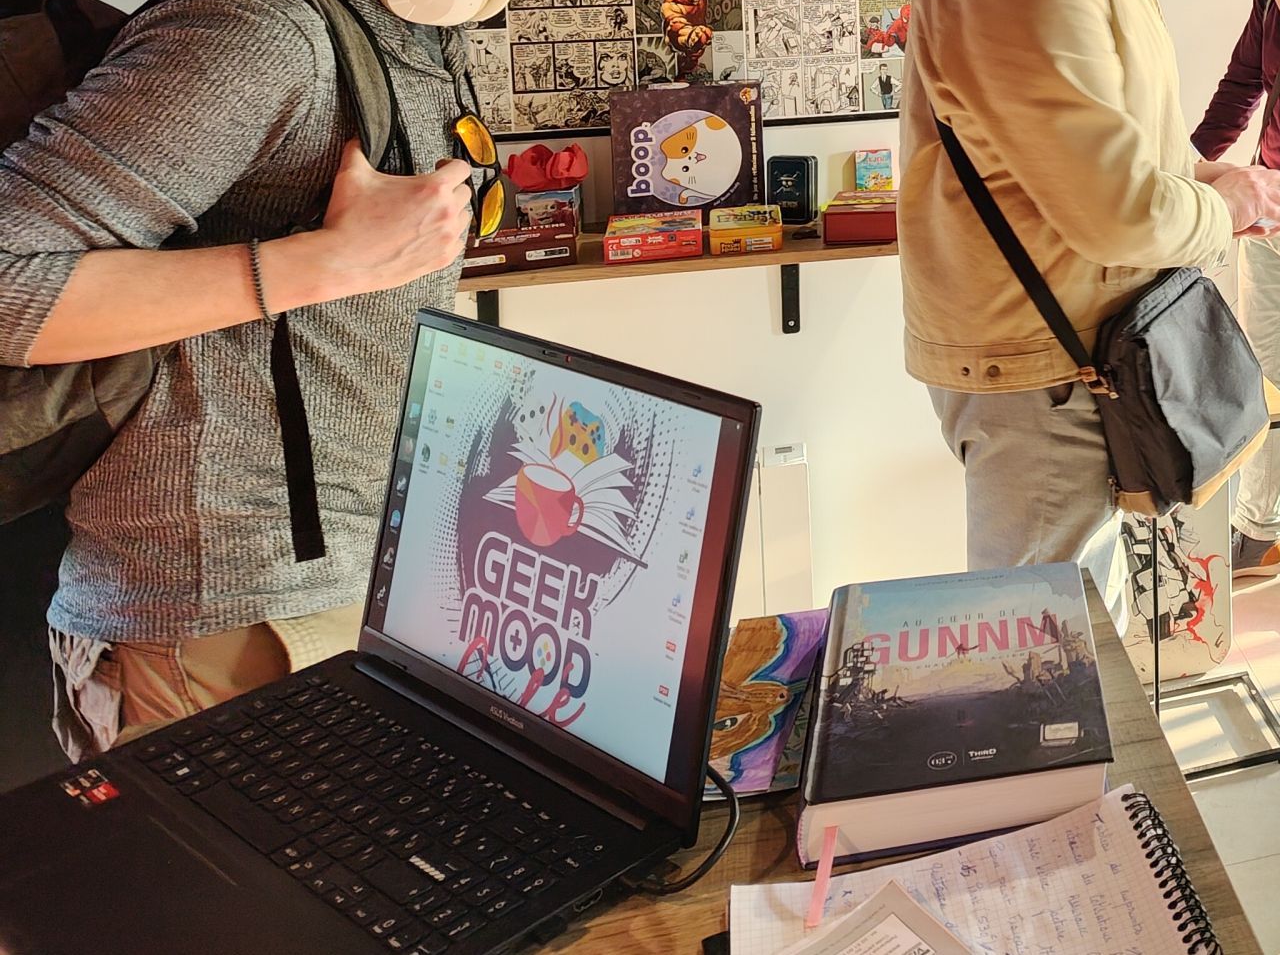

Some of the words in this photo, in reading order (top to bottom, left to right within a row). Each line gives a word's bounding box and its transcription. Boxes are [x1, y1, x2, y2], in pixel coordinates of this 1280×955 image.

[521, 222, 566, 231] KITTENS
[475, 532, 599, 641] GEEK
[902, 619, 922, 628] AU
[999, 608, 1017, 618] DE
[458, 591, 592, 699] MOOD
[863, 612, 1060, 665] GUNNM
[967, 747, 997, 758] THIRD
